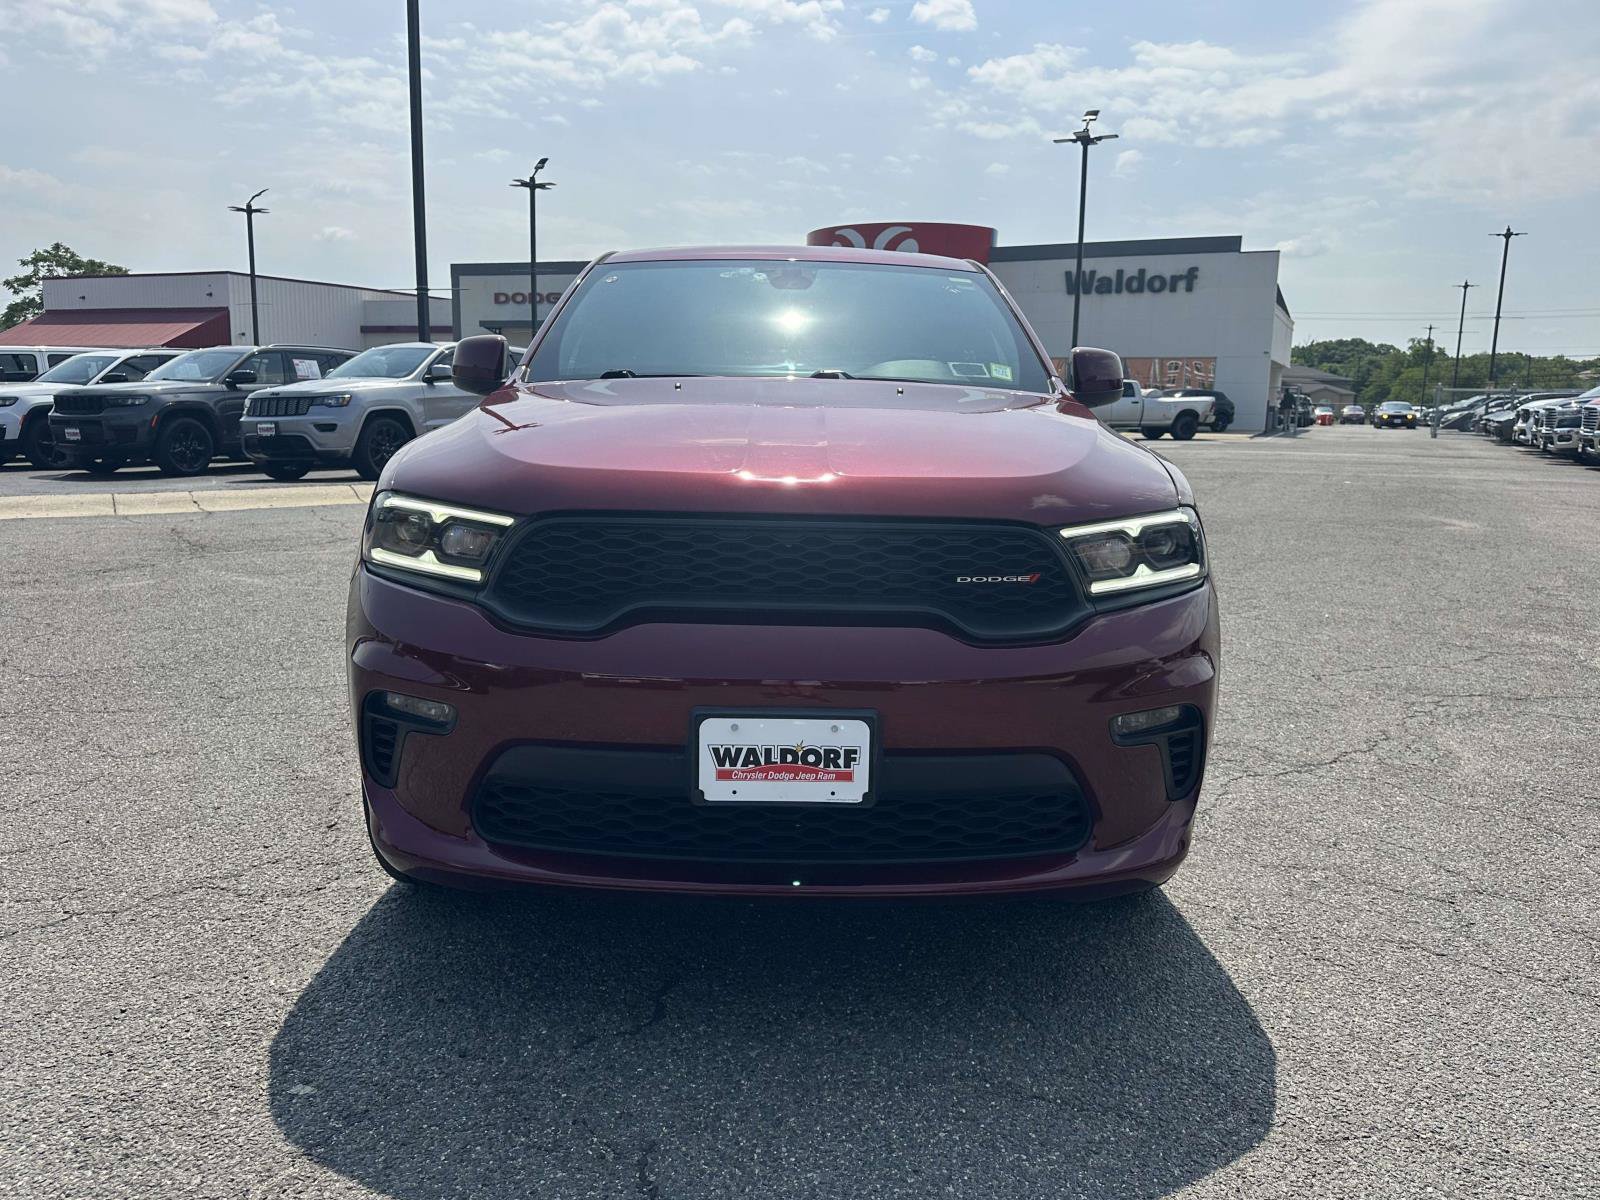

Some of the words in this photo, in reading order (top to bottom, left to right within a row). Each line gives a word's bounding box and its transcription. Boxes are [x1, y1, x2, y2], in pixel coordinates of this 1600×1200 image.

[1065, 267, 1199, 295] Waldorf
[494, 292, 562, 304] DODG
[957, 575, 1031, 583] DODGE
[711, 746, 859, 769] WALDORF
[732, 771, 766, 781] Chrysler
[768, 771, 794, 781] Dodge
[795, 772, 816, 782] Jeep
[818, 772, 836, 781] Ram
